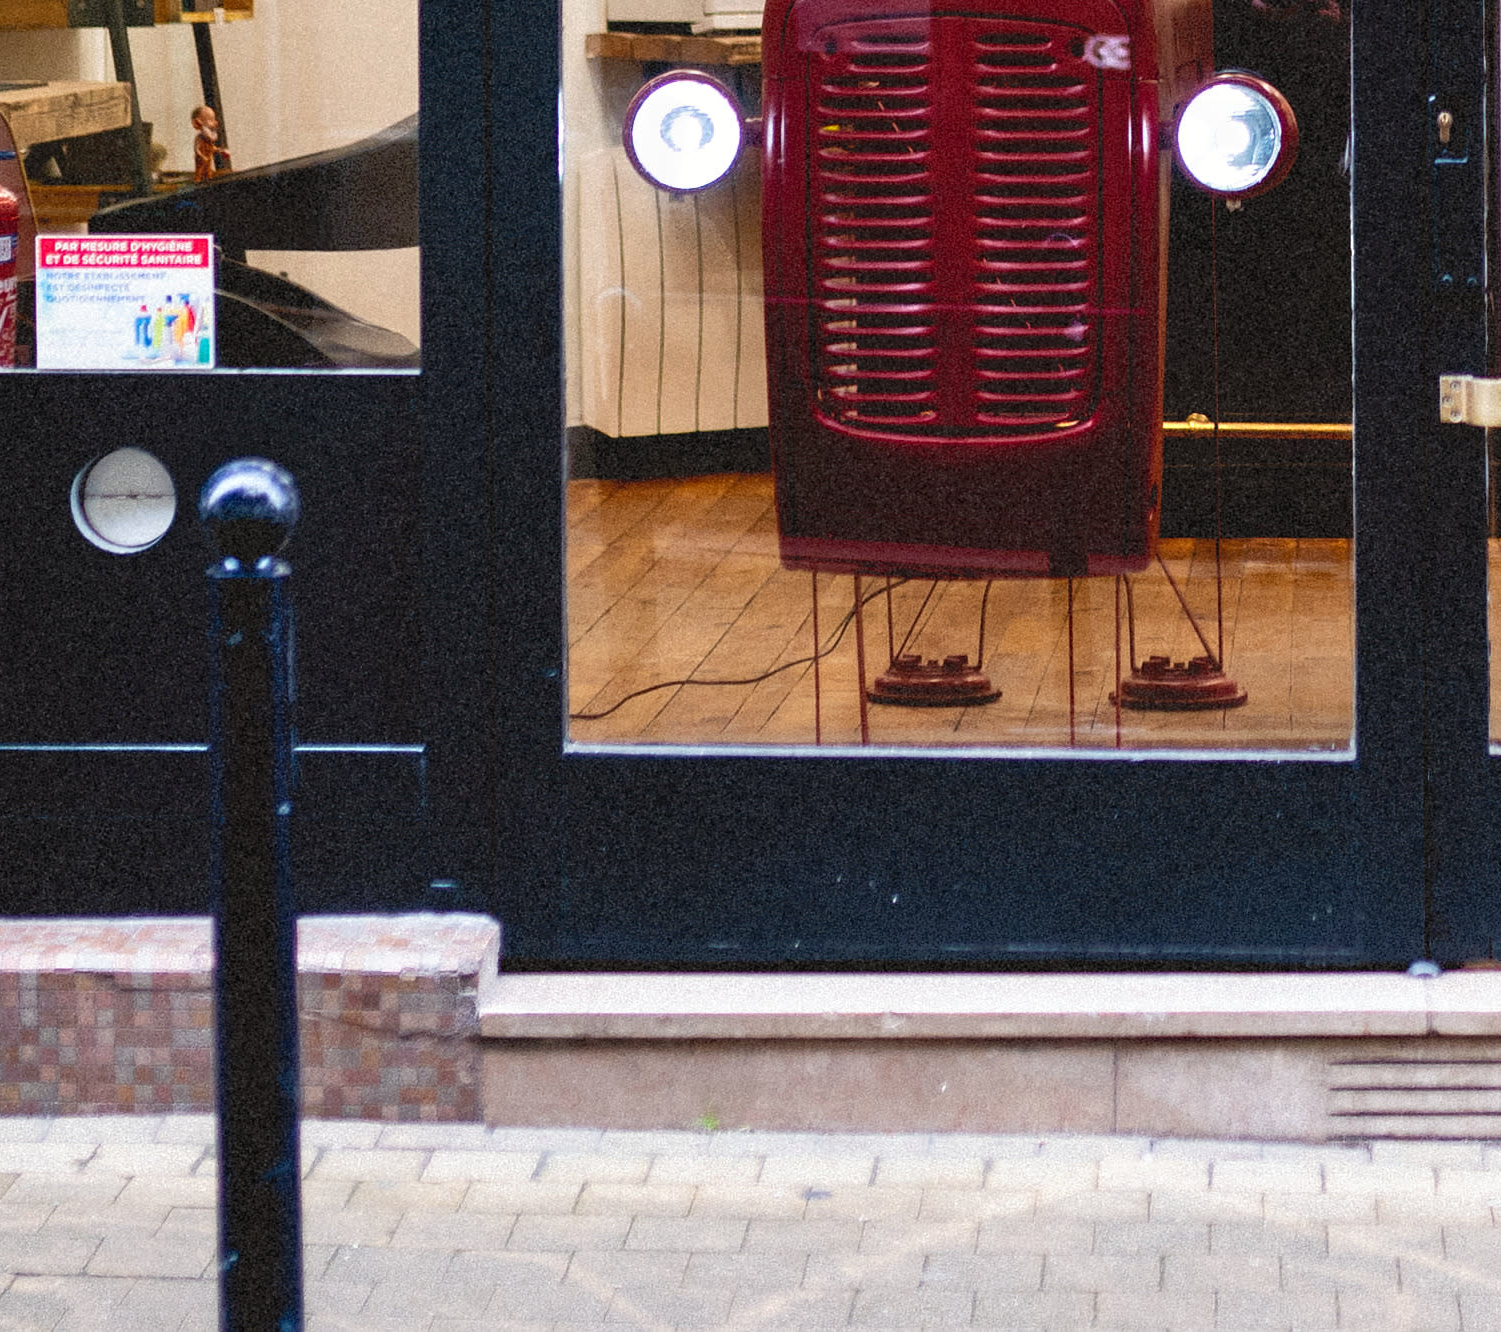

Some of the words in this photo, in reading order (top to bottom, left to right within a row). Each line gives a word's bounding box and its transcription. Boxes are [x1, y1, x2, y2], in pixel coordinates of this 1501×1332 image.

[55, 241, 78, 252] PAR
[80, 241, 128, 252] MESURE
[45, 255, 61, 265] ET
[63, 255, 80, 265] DE
[82, 253, 139, 265] SÉCURITÉ
[140, 254, 203, 265] SANITAIRE
